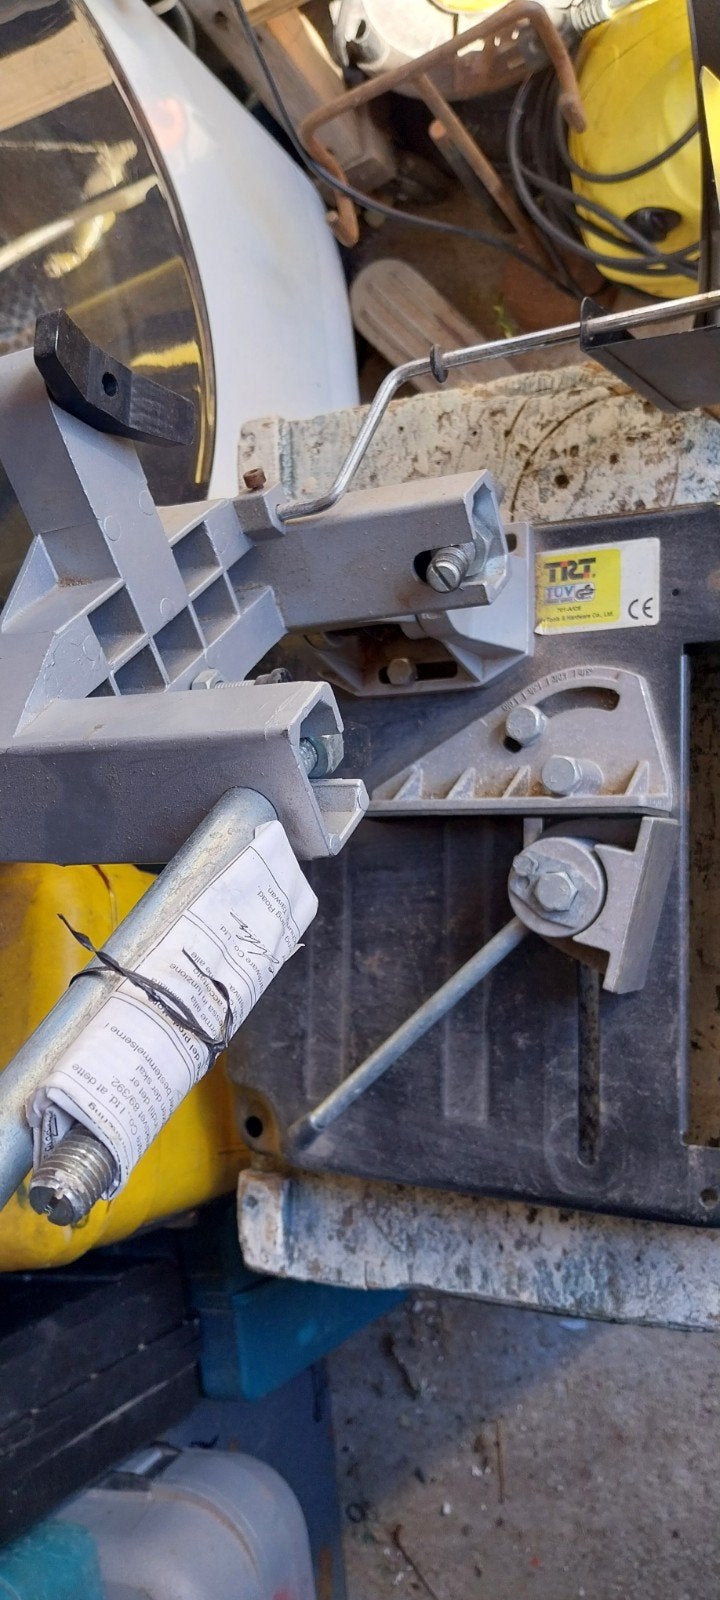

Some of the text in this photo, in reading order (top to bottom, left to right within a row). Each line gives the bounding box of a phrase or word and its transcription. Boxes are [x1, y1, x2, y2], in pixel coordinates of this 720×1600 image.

[544, 557, 596, 583] TRT
[628, 597, 653, 620] CE
[108, 1025, 172, 1096] bestemmelserne
[70, 1062, 97, 1086] dette
[128, 1075, 140, 1087] er
[134, 1063, 153, 1084] skal
[95, 1083, 108, 1095] at
[137, 1086, 150, 1105] det
